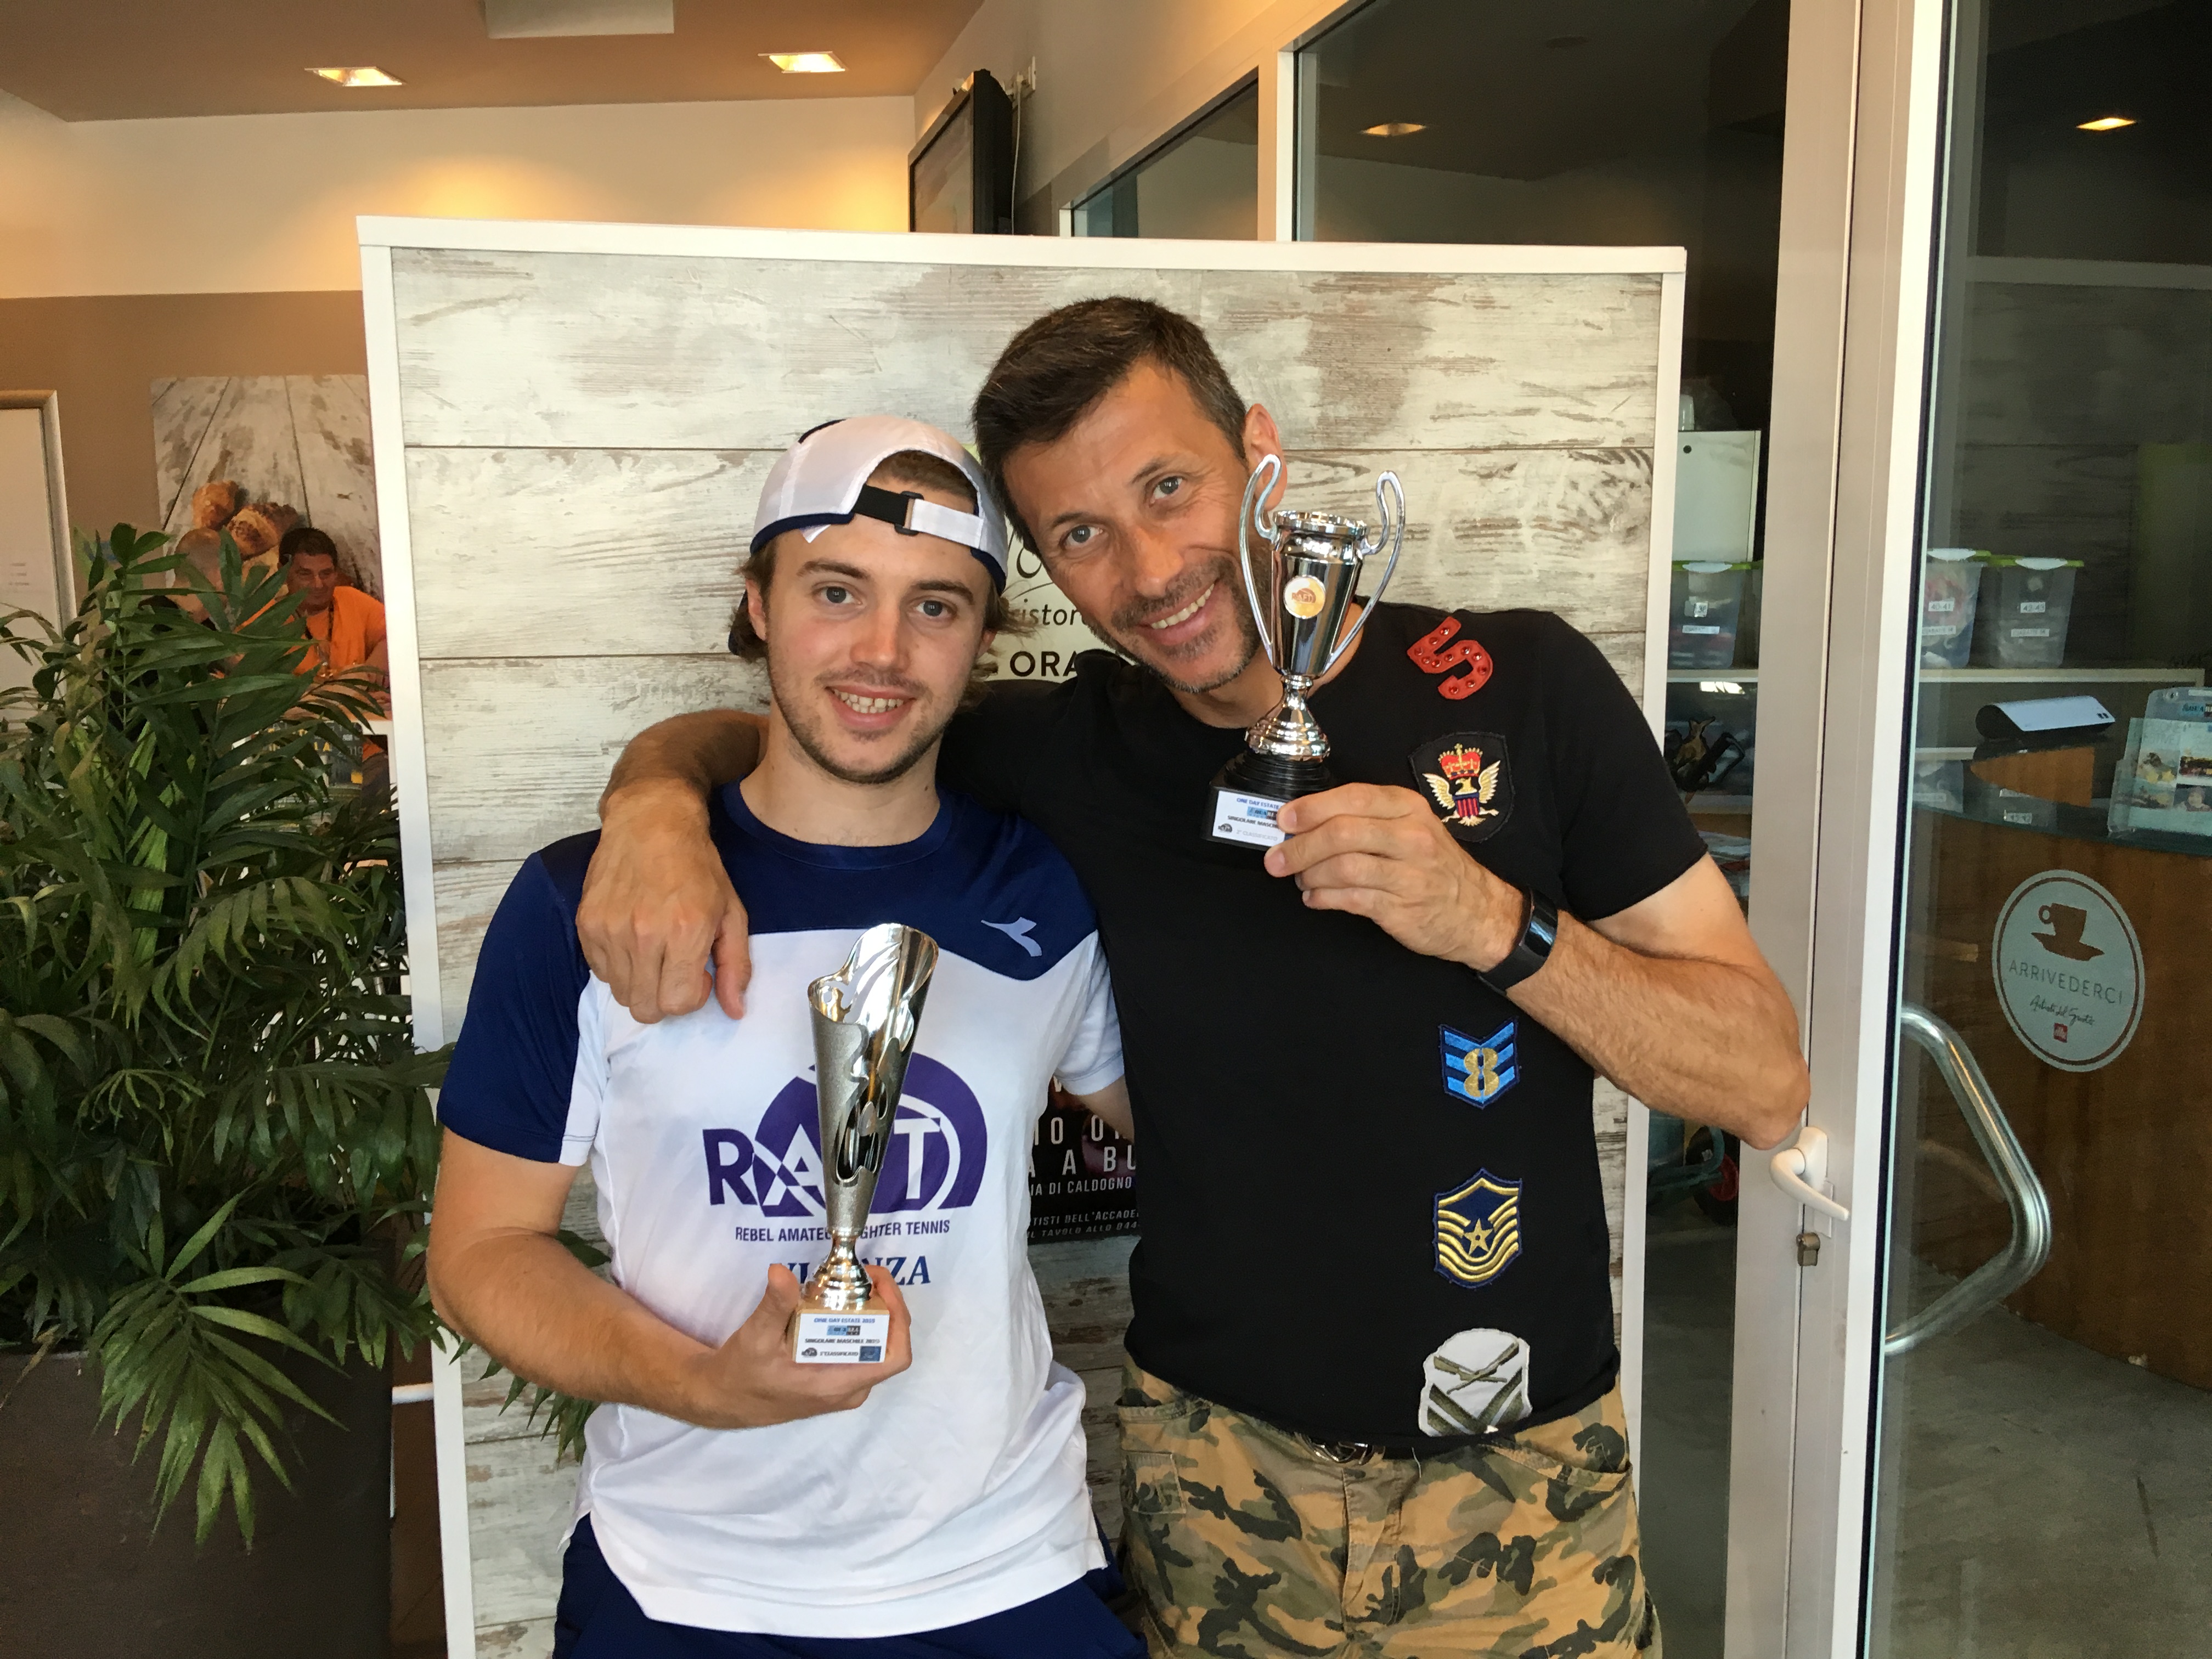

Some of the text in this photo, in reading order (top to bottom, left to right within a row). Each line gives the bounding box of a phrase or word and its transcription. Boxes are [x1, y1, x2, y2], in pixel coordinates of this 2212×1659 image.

[2008, 960, 2123, 1005] ARRIVEDERCI
[1463, 1047, 1499, 1098] 8
[1049, 1181, 1061, 1195] DI
[1067, 1176, 1132, 1194] CALDOGNO
[735, 1226, 774, 1242] REBEL
[905, 1219, 951, 1235] TENNIS
[1033, 1215, 1059, 1227] TISTI
